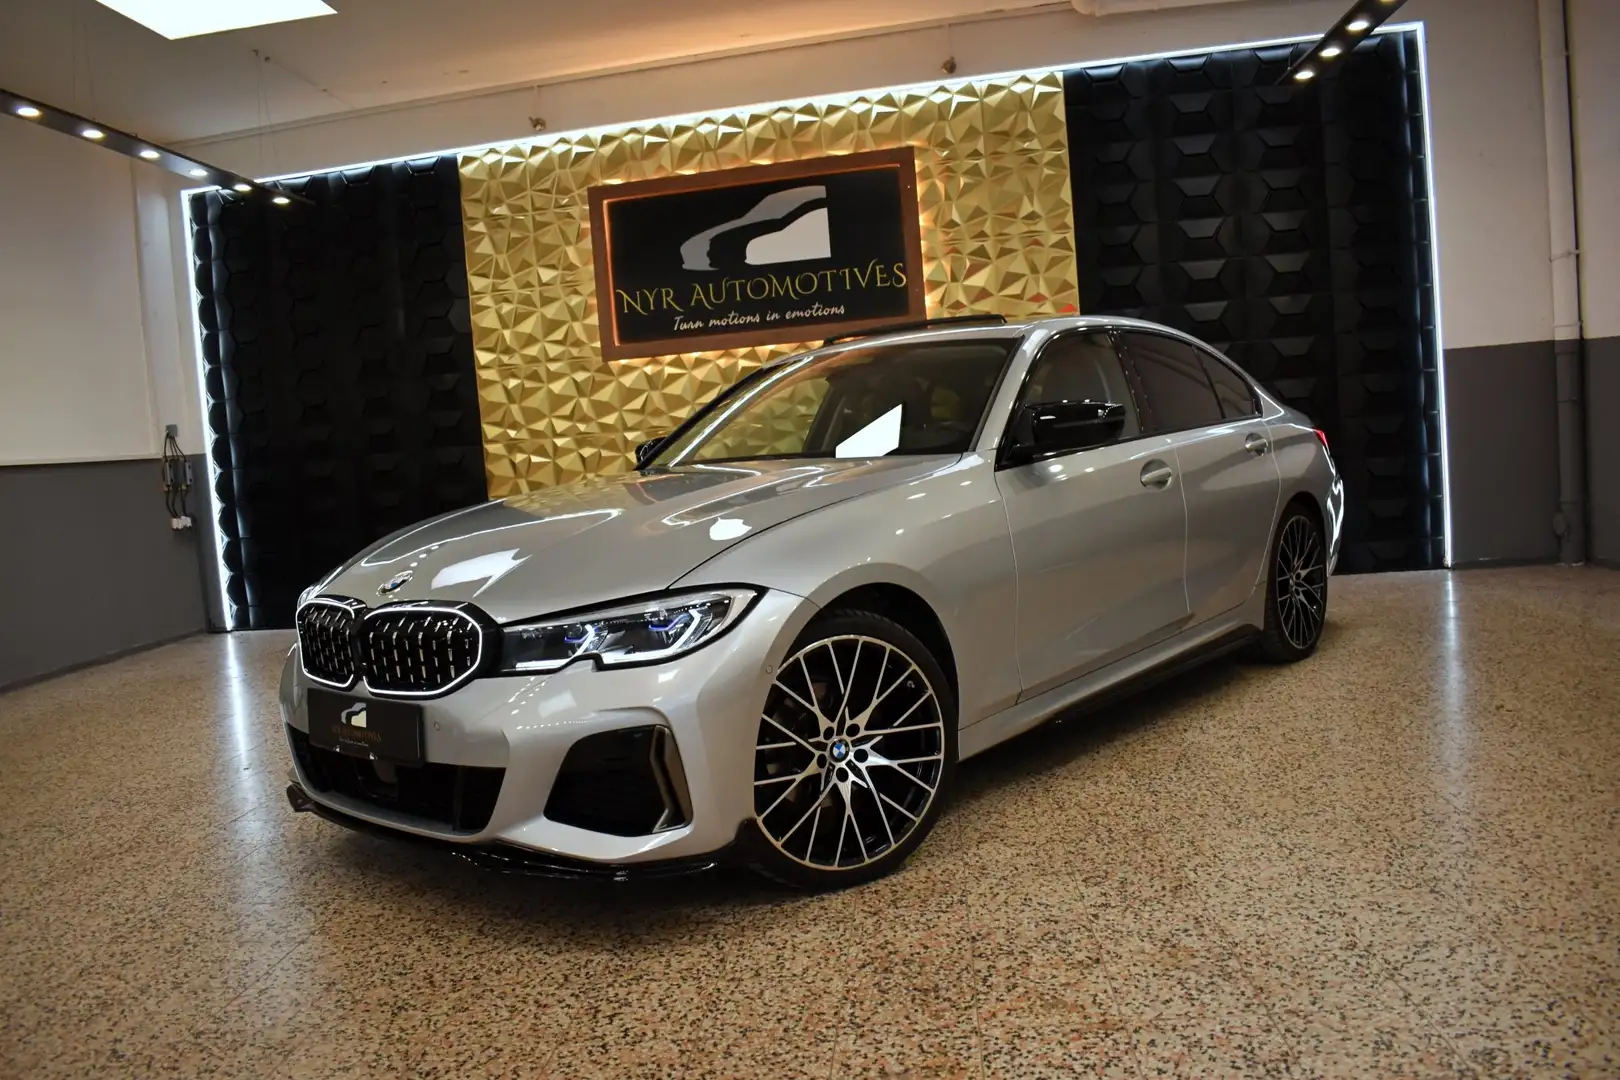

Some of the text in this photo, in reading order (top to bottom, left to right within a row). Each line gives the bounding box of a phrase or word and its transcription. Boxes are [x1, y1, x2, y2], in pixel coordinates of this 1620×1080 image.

[616, 258, 907, 315] NYR AUTOMOTIVES
[673, 301, 846, 332] Turn motions in emotions
